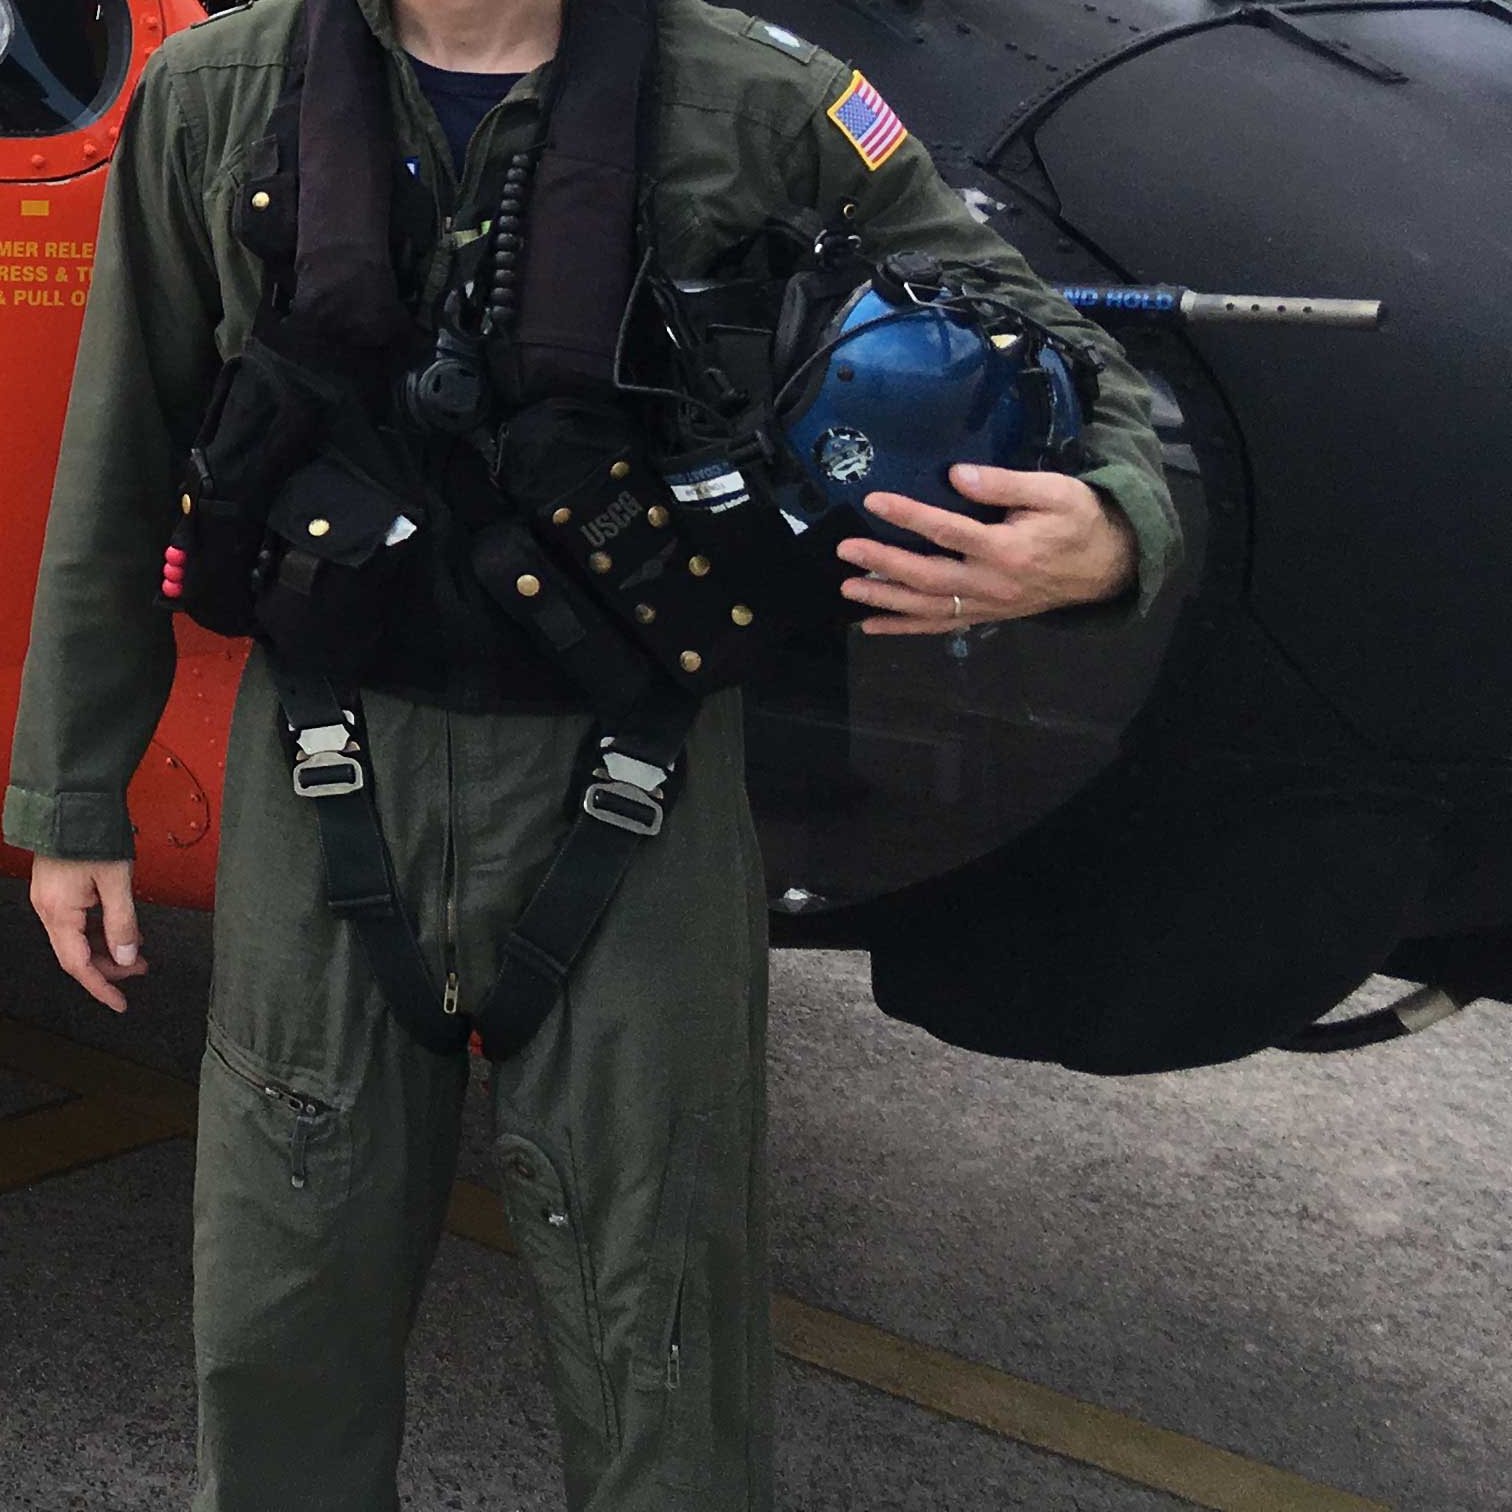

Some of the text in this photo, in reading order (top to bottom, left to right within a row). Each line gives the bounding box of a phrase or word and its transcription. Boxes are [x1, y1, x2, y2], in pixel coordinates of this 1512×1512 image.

[44, 242, 95, 259] RELE
[55, 267, 69, 282] &
[13, 290, 64, 306] PULL
[1106, 290, 1174, 310] HOLD
[580, 490, 644, 548] USCG
